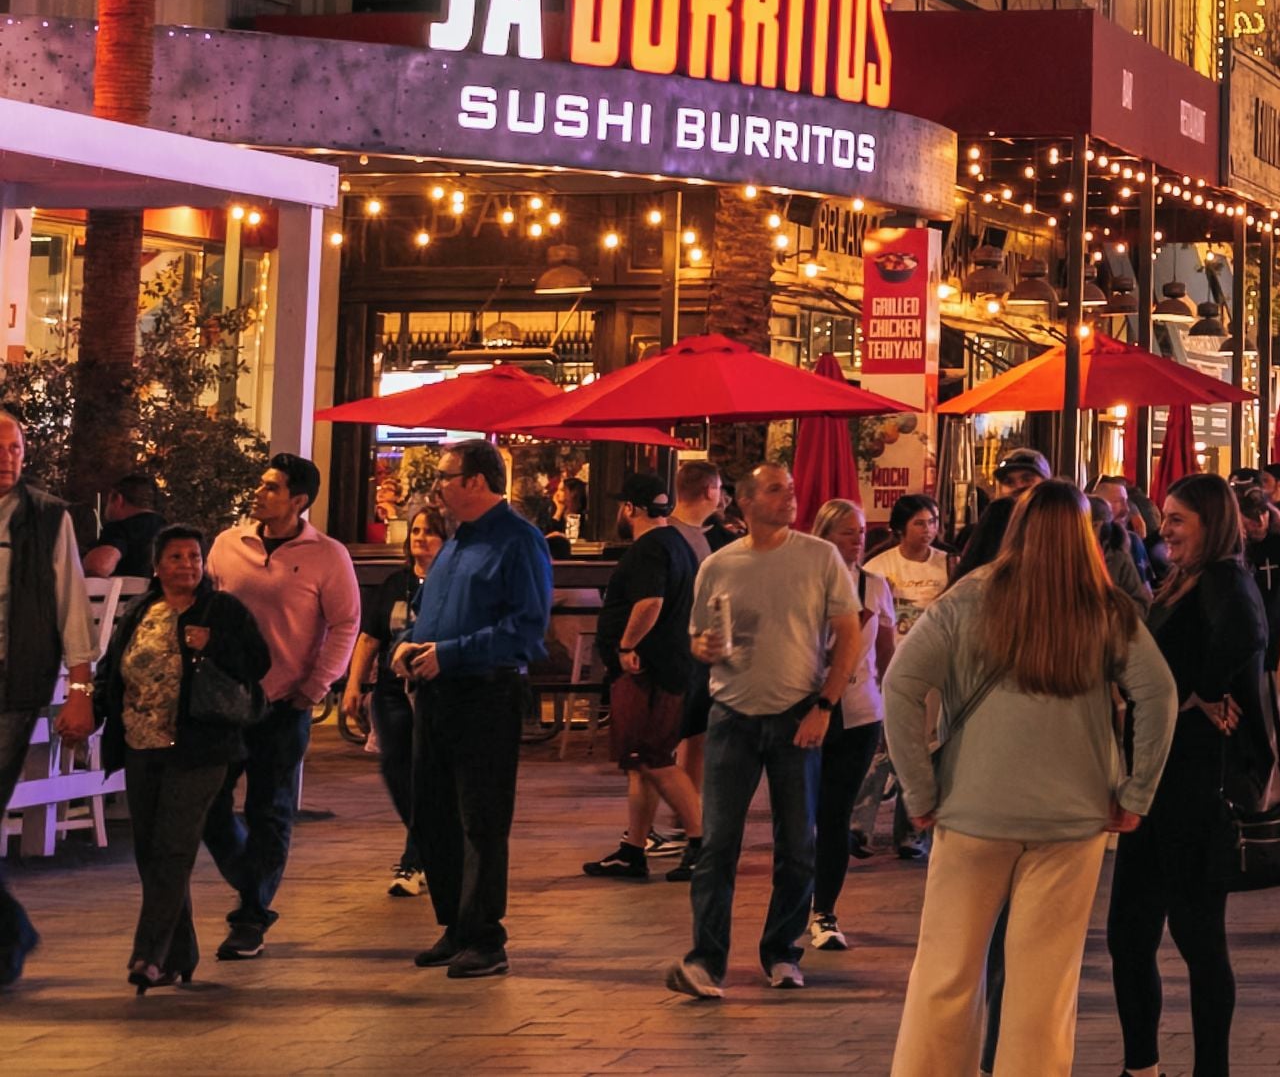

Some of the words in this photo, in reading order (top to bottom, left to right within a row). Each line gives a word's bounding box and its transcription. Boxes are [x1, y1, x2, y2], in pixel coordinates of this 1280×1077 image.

[458, 84, 652, 145] SUSHI
[675, 106, 877, 173] BURRITOS
[872, 296, 920, 317] GRILLED
[869, 318, 921, 338] CHICKEN
[867, 340, 923, 360] TERIYAKI
[871, 467, 909, 486] MOCHI
